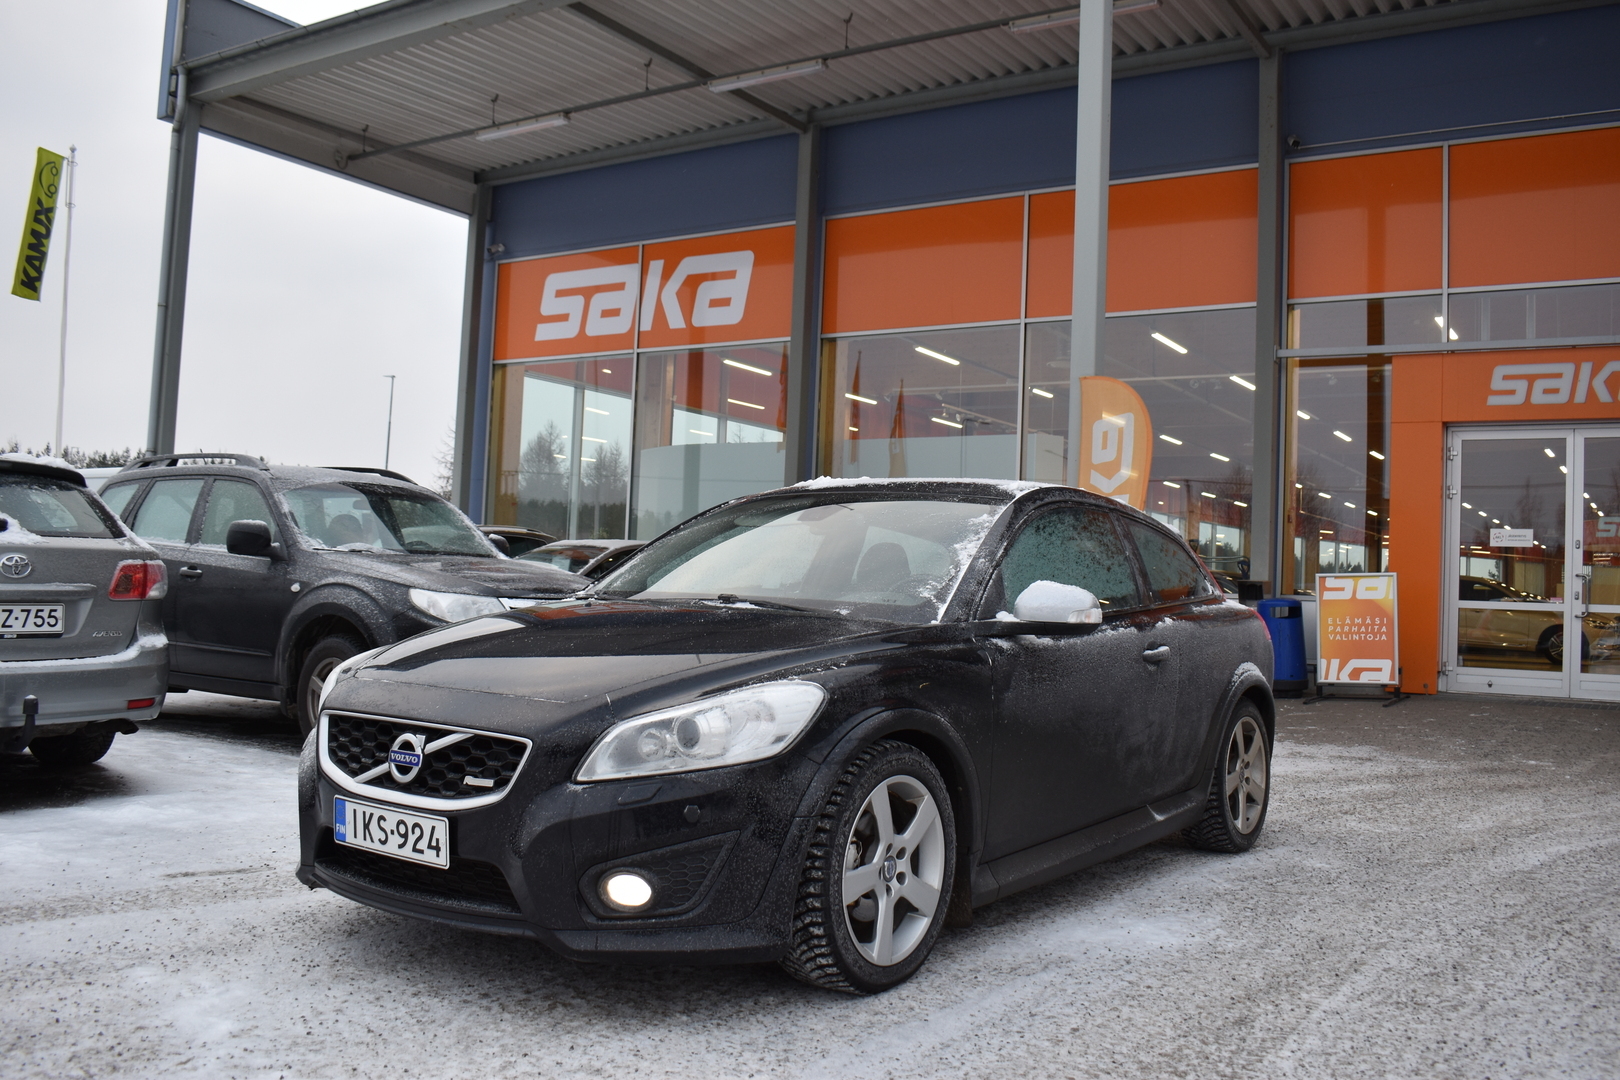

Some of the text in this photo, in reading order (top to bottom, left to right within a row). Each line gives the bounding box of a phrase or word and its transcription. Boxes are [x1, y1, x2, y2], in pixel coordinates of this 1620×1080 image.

[20, 197, 54, 293] KAMUX
[1486, 360, 1620, 406] sak
[1322, 576, 1394, 600] sa
[0, 608, 59, 629] Z-755
[1327, 616, 1387, 624] ELÄMÄSI
[1327, 633, 1387, 641] VALINTOJA
[390, 752, 419, 765] VOLVO
[336, 823, 346, 835] FIN
[352, 808, 442, 858] IKS-924
